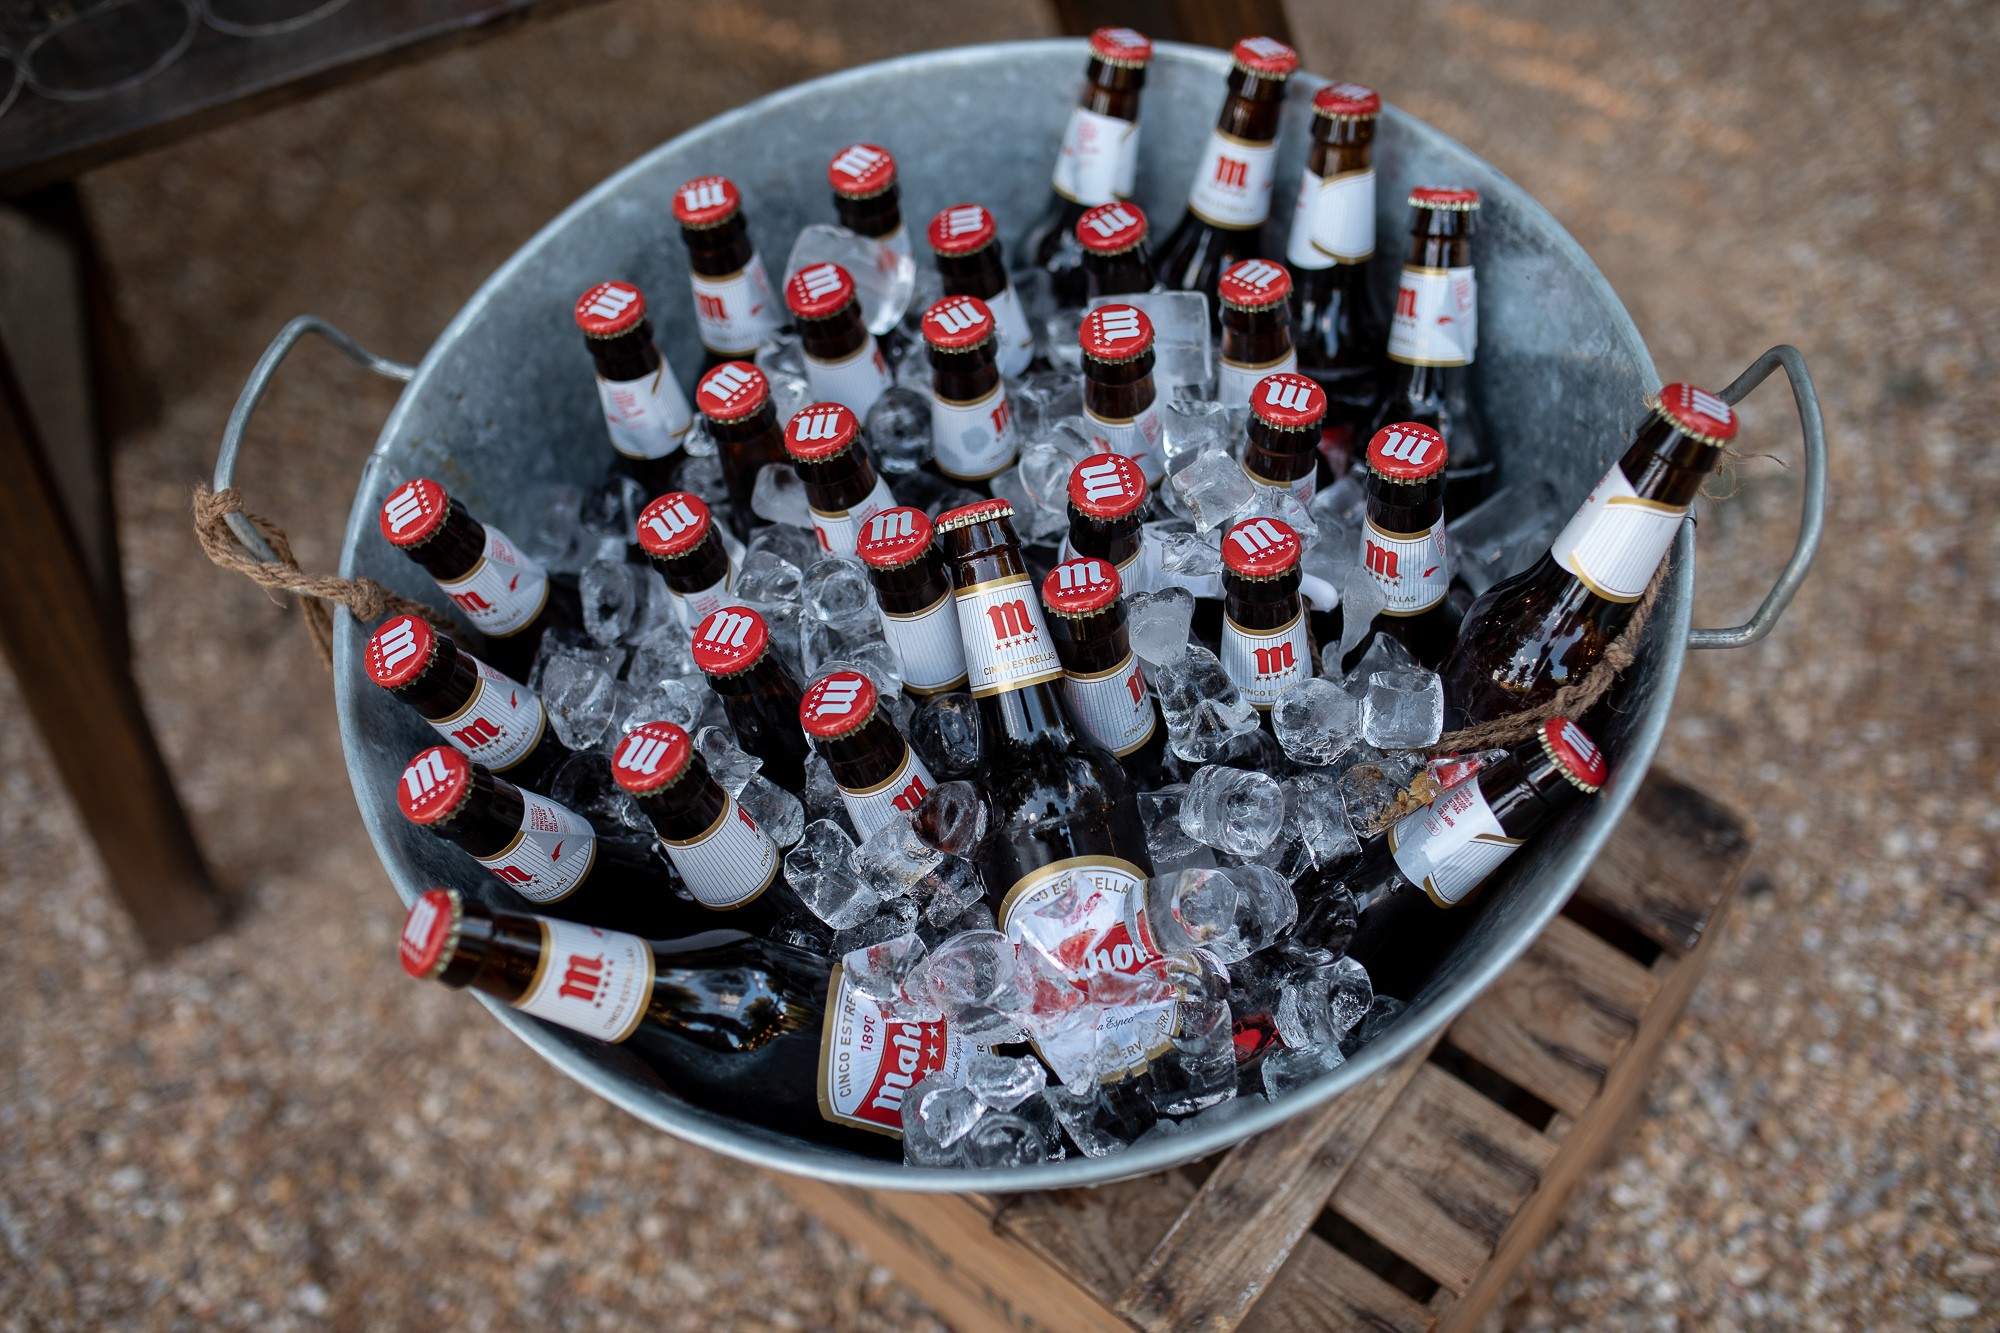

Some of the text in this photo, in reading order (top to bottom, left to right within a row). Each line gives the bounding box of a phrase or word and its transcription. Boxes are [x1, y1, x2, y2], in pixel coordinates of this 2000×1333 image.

[1234, 261, 1281, 288] m
[936, 305, 985, 334] m
[1102, 308, 1140, 341] m
[702, 365, 752, 400] m
[1266, 382, 1312, 412] m
[796, 414, 838, 441] m
[1381, 430, 1432, 464] m
[1080, 461, 1123, 502] m
[385, 487, 422, 533] m
[648, 502, 699, 541] m
[870, 512, 915, 541] m
[1230, 520, 1285, 554] m
[1056, 562, 1105, 589] m
[1366, 539, 1401, 579] m
[704, 611, 753, 647] m
[986, 599, 1035, 640] m
[380, 619, 416, 669] m
[1252, 641, 1296, 674] m
[984, 652, 1056, 676] CINCO ESTRELLAS
[816, 679, 862, 716] m
[1239, 686, 1266, 697] CINCO
[451, 717, 500, 749] m
[491, 725, 530, 761] ESTRELLAS
[1124, 720, 1146, 738] CINCO
[618, 735, 669, 774] m
[402, 750, 452, 800] m
[558, 953, 603, 1002] m
[839, 1052, 852, 1098] CINCO
